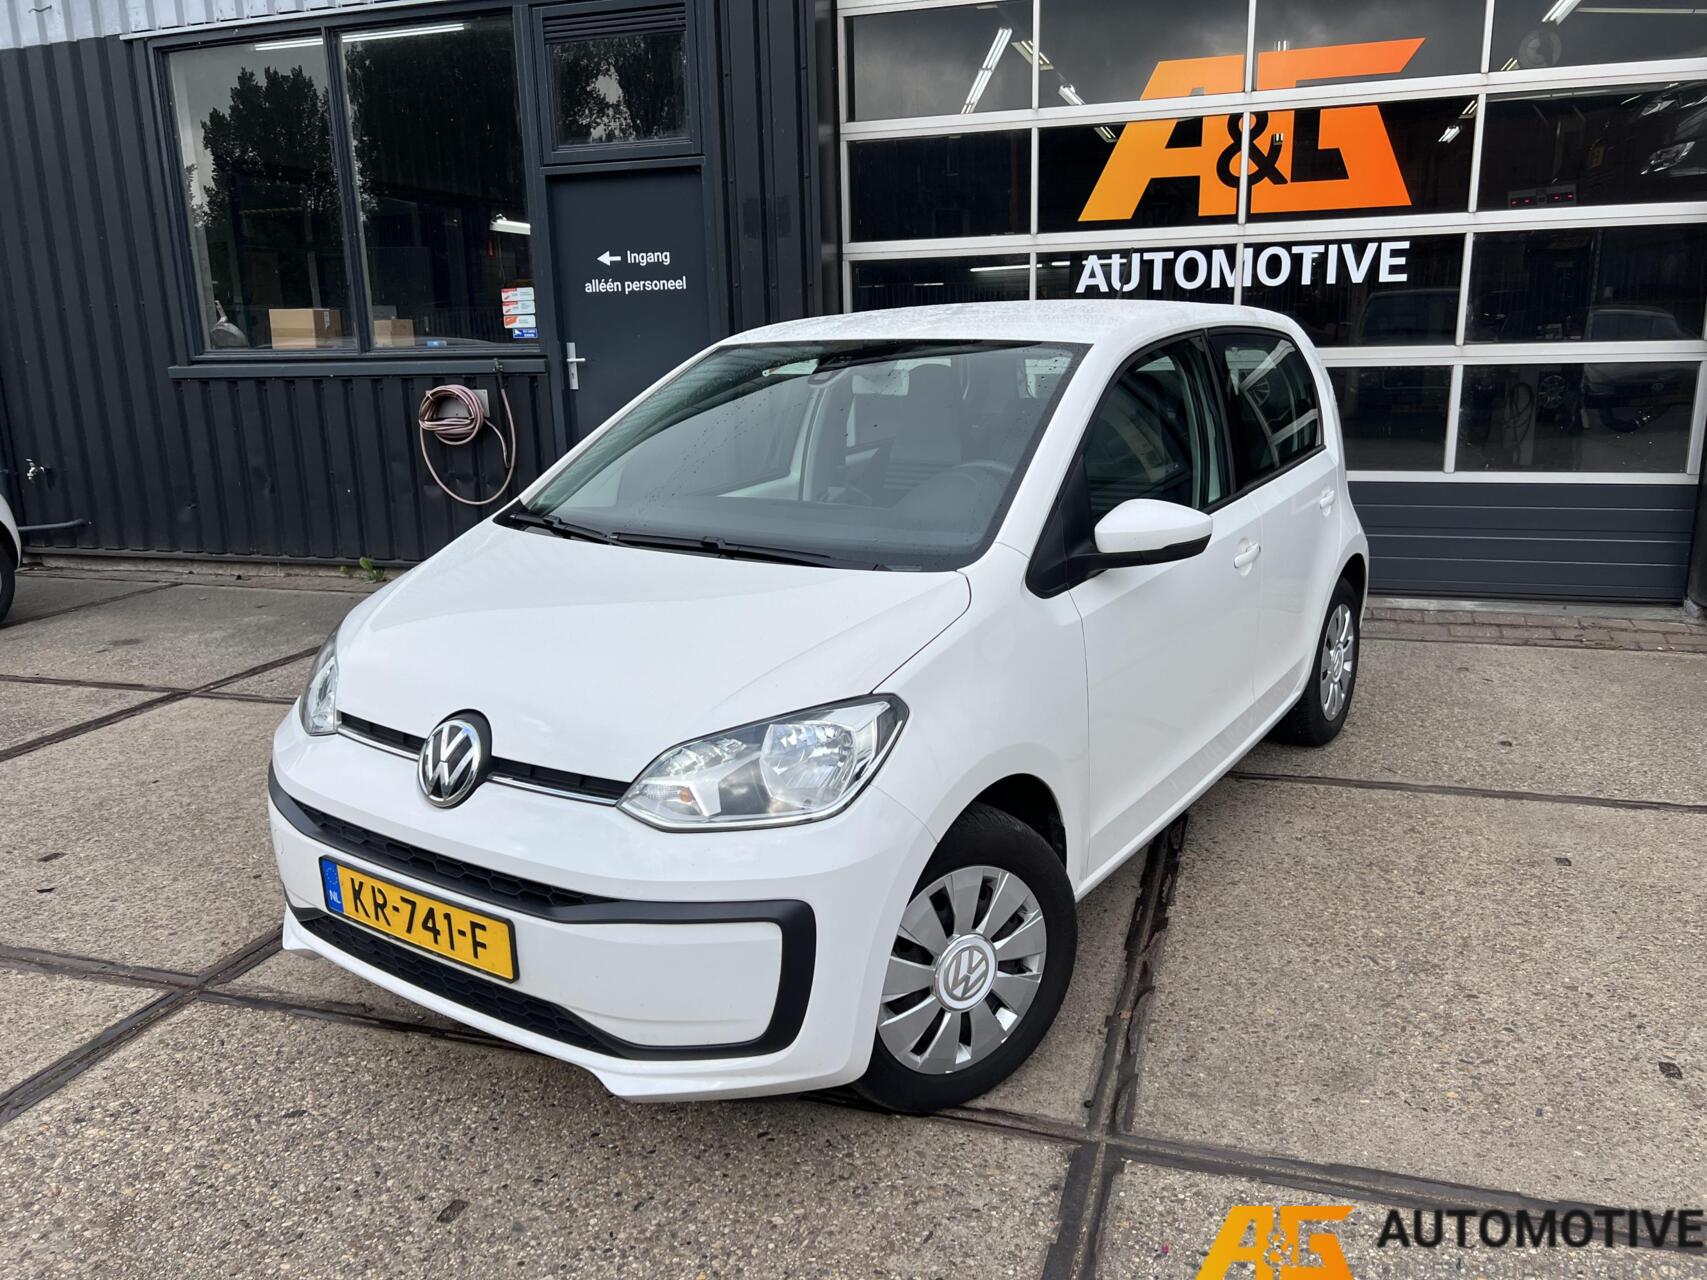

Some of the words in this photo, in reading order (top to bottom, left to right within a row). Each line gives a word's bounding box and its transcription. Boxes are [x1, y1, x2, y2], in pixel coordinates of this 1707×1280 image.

[584, 278, 622, 293] alléén
[624, 275, 687, 295] personeel
[626, 250, 671, 266] Ingang
[1075, 240, 1411, 294] AUTOMOTIVE
[419, 720, 481, 804] VW
[328, 889, 342, 905] NL
[350, 876, 488, 960] KR-741-F
[943, 946, 990, 1001] VW
